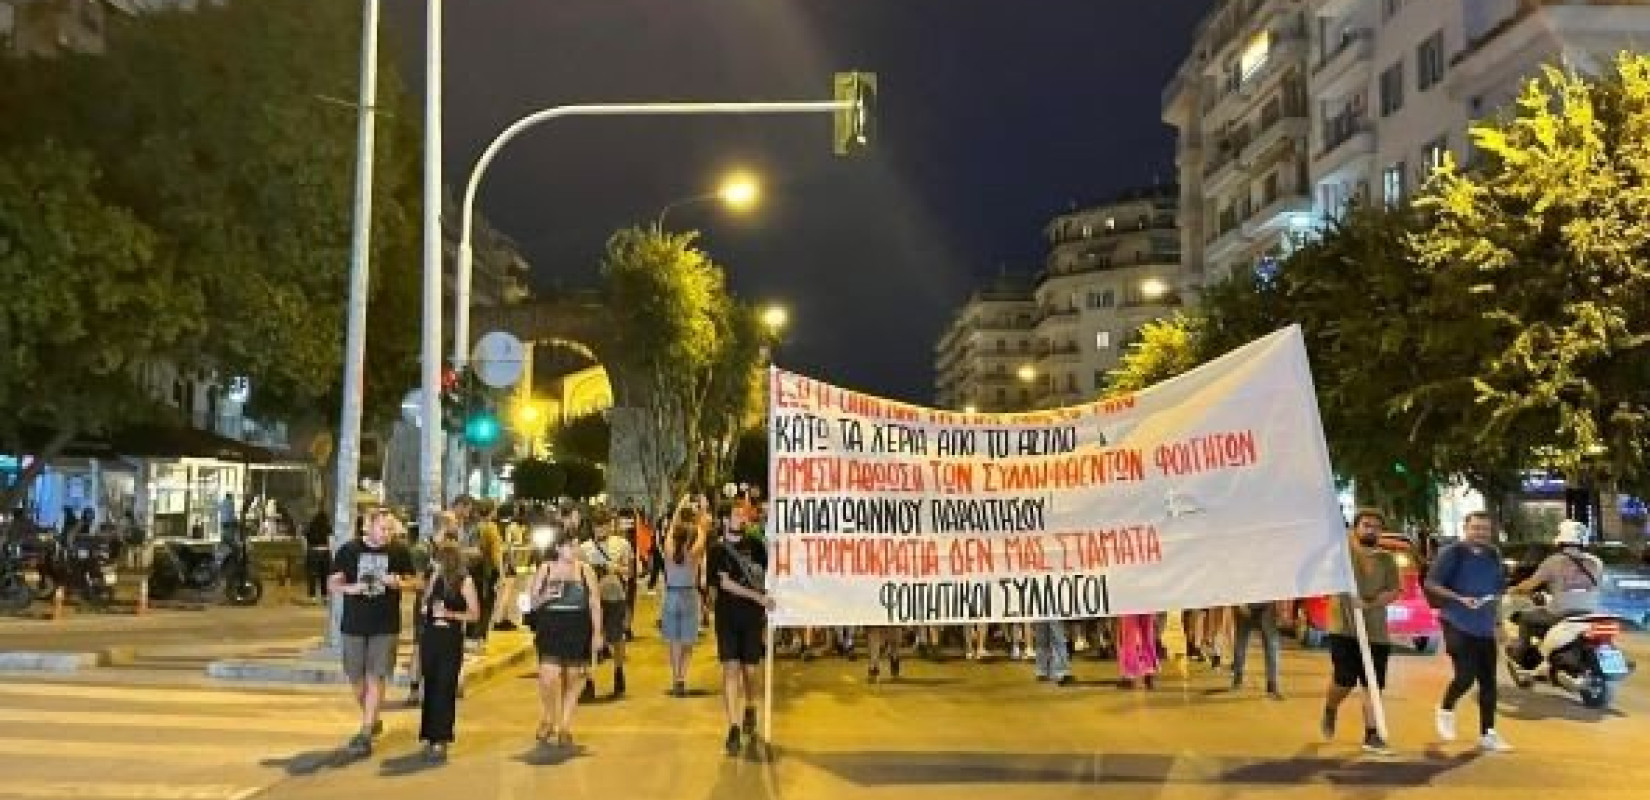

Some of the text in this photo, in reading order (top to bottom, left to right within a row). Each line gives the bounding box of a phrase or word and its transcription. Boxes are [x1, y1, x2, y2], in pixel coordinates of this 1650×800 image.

[775, 414, 829, 453] ΚΑΤΩ
[837, 418, 864, 453] ΤΑ
[870, 423, 928, 456] ΧΕΡΙΑ
[937, 429, 975, 458] ΑΠΟ
[982, 429, 1009, 459] ΤΟ
[775, 429, 1258, 495] ΑΜΕΣΗ ΑΘΩΩΣΗ ΤΩΝ ΣΥΛΛΗΦΘΕΝΤΩΝ ΦΟΙΤΗΤΩΝ
[775, 524, 1162, 578] Η ΤΡΟΜΟΚΡΑΤΙΑ ΔΕΝ ΜΑΣ ΣΤΑΜΑΤΑ
[879, 574, 1110, 623] ΦΟΙΤΗΤΙΚΟΙ ΣΥΛΛΟΓΟΙ
